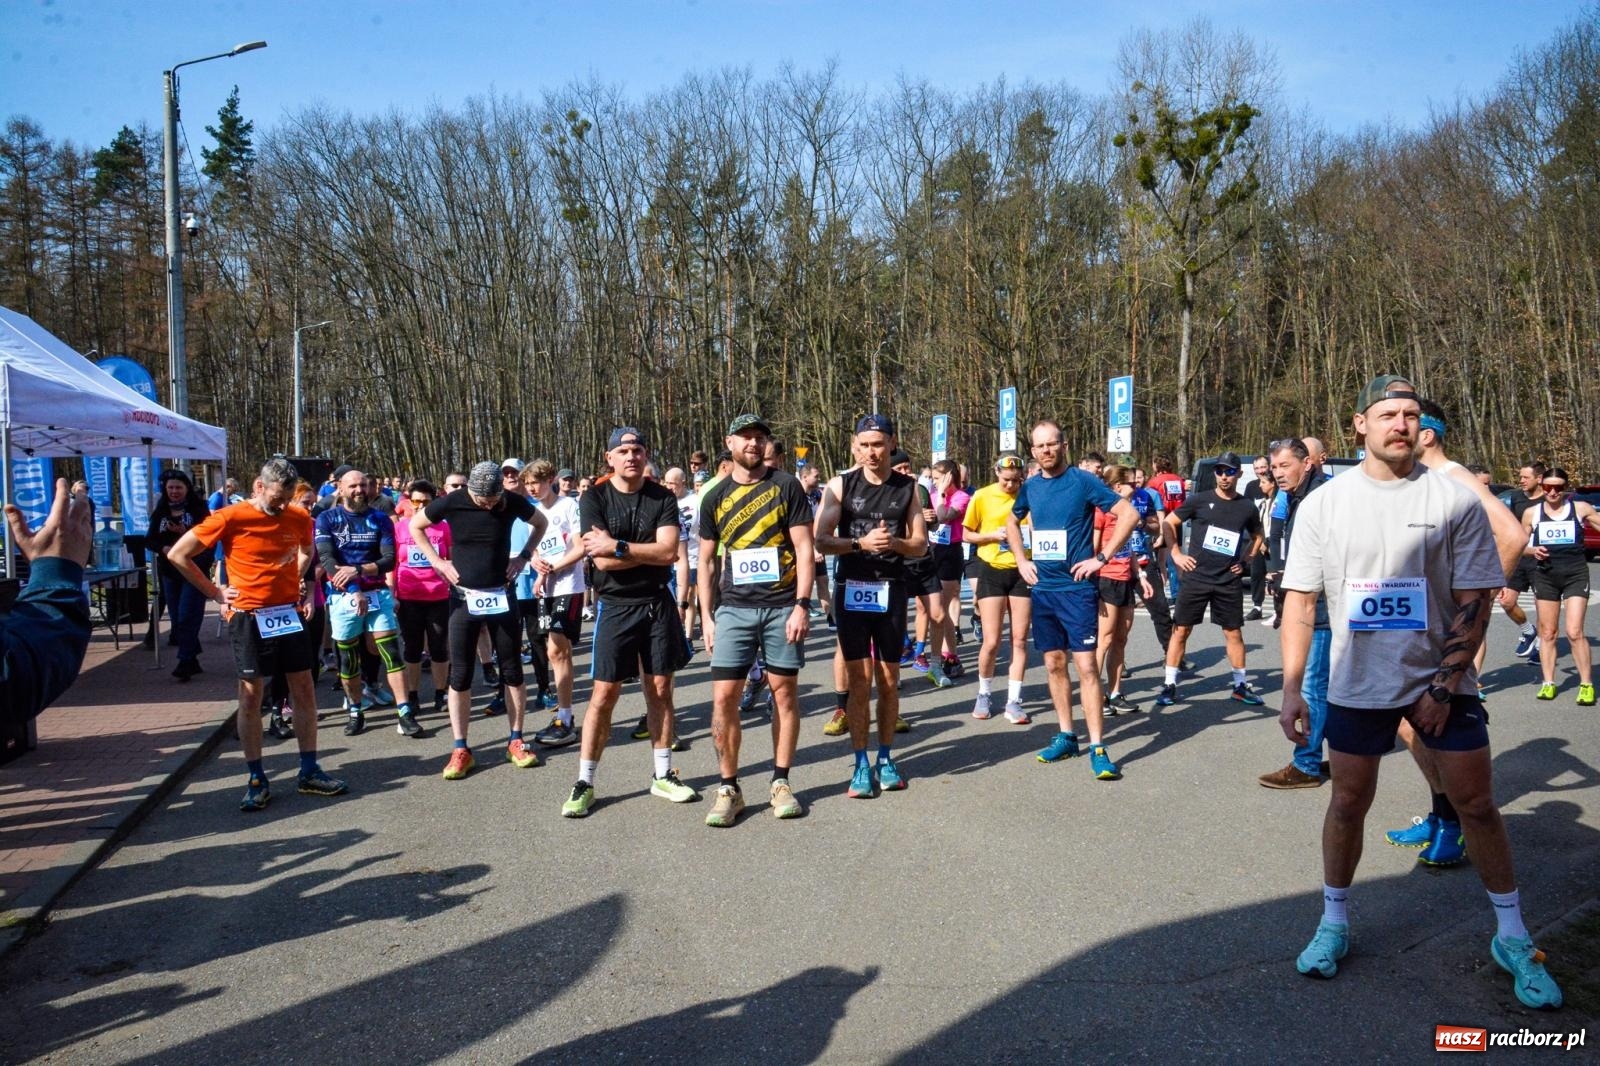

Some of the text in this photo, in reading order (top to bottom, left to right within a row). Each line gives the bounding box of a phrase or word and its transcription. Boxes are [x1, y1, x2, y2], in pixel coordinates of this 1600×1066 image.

[1114, 382, 1127, 413] P
[1003, 393, 1012, 418] P
[935, 418, 943, 440] P
[1546, 529, 1567, 538] 031
[541, 537, 557, 550] 037
[1038, 541, 1059, 551] 104
[1212, 535, 1231, 548] 125
[413, 552, 427, 561] 00
[740, 559, 770, 574] 080
[475, 596, 498, 608] 021
[853, 590, 879, 603] 051
[1361, 597, 1412, 617] 055
[265, 614, 292, 628] 076
